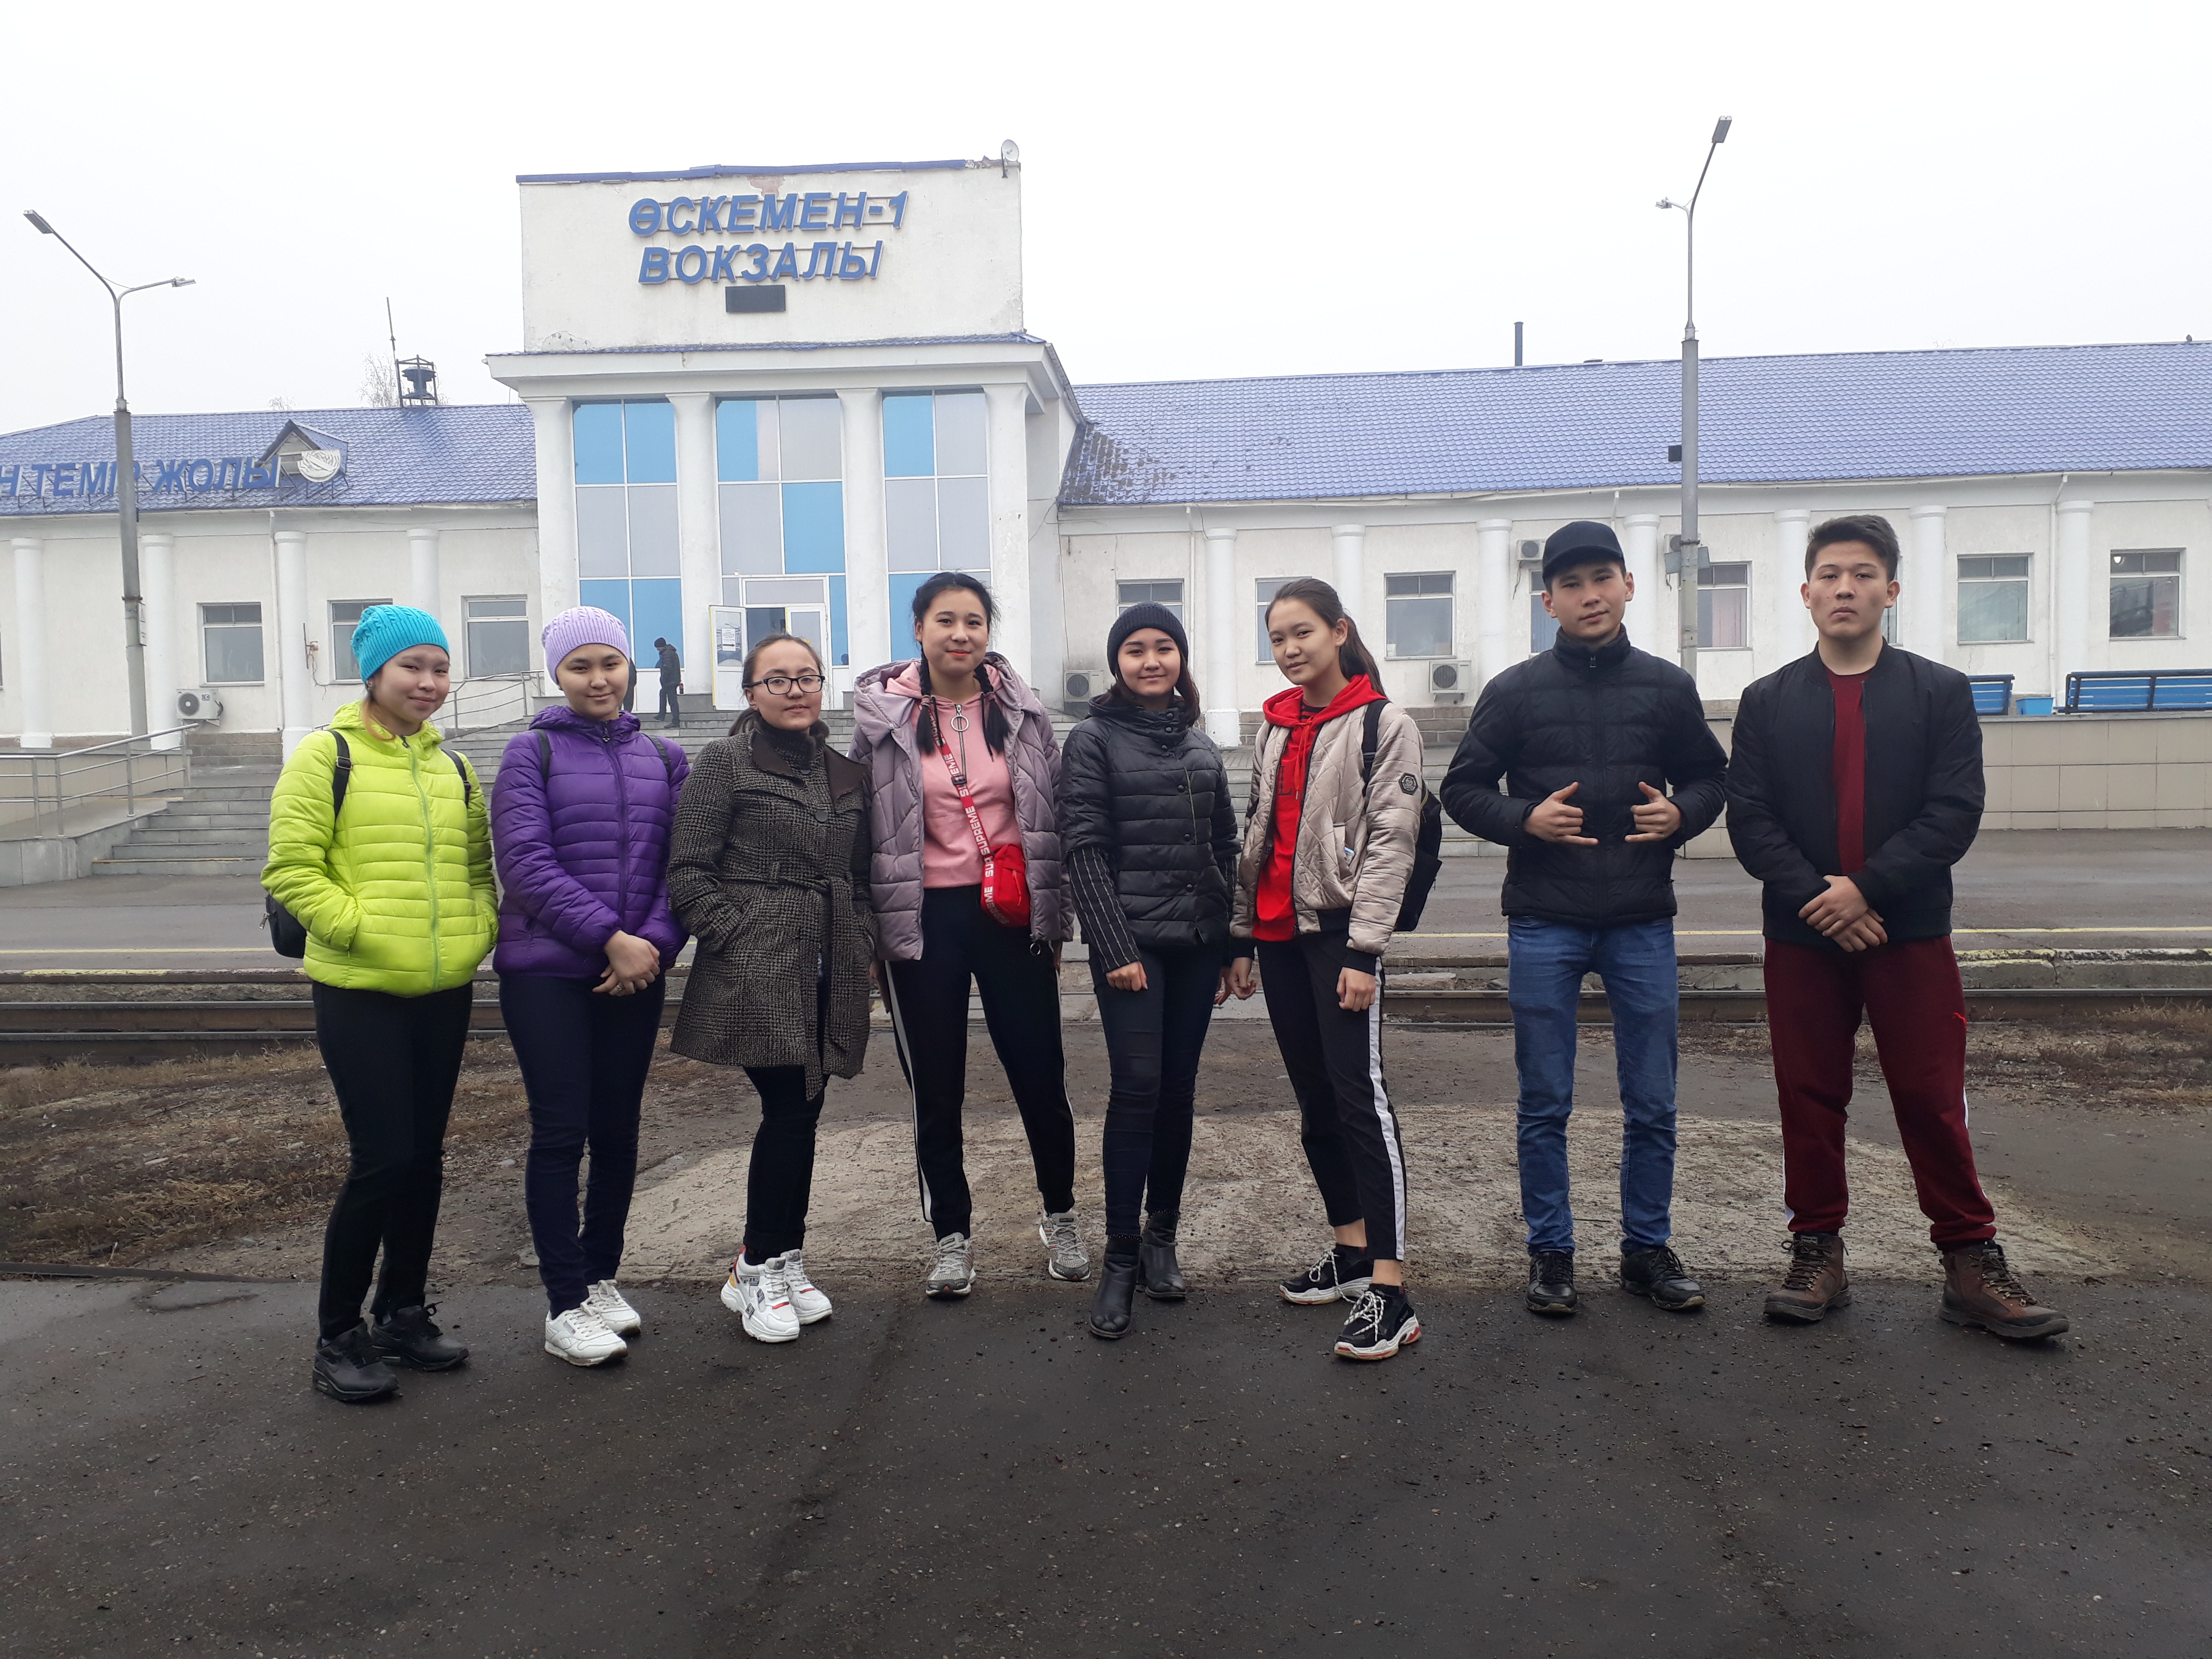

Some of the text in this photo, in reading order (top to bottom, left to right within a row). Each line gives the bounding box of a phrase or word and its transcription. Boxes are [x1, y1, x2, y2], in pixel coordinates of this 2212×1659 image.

[629, 190, 908, 236] ӨСКЕМЕН-1
[638, 240, 884, 284] ВОКЗАЛЫ
[153, 456, 281, 492] ЖОЛЫ
[965, 805, 990, 856] SUPREME
